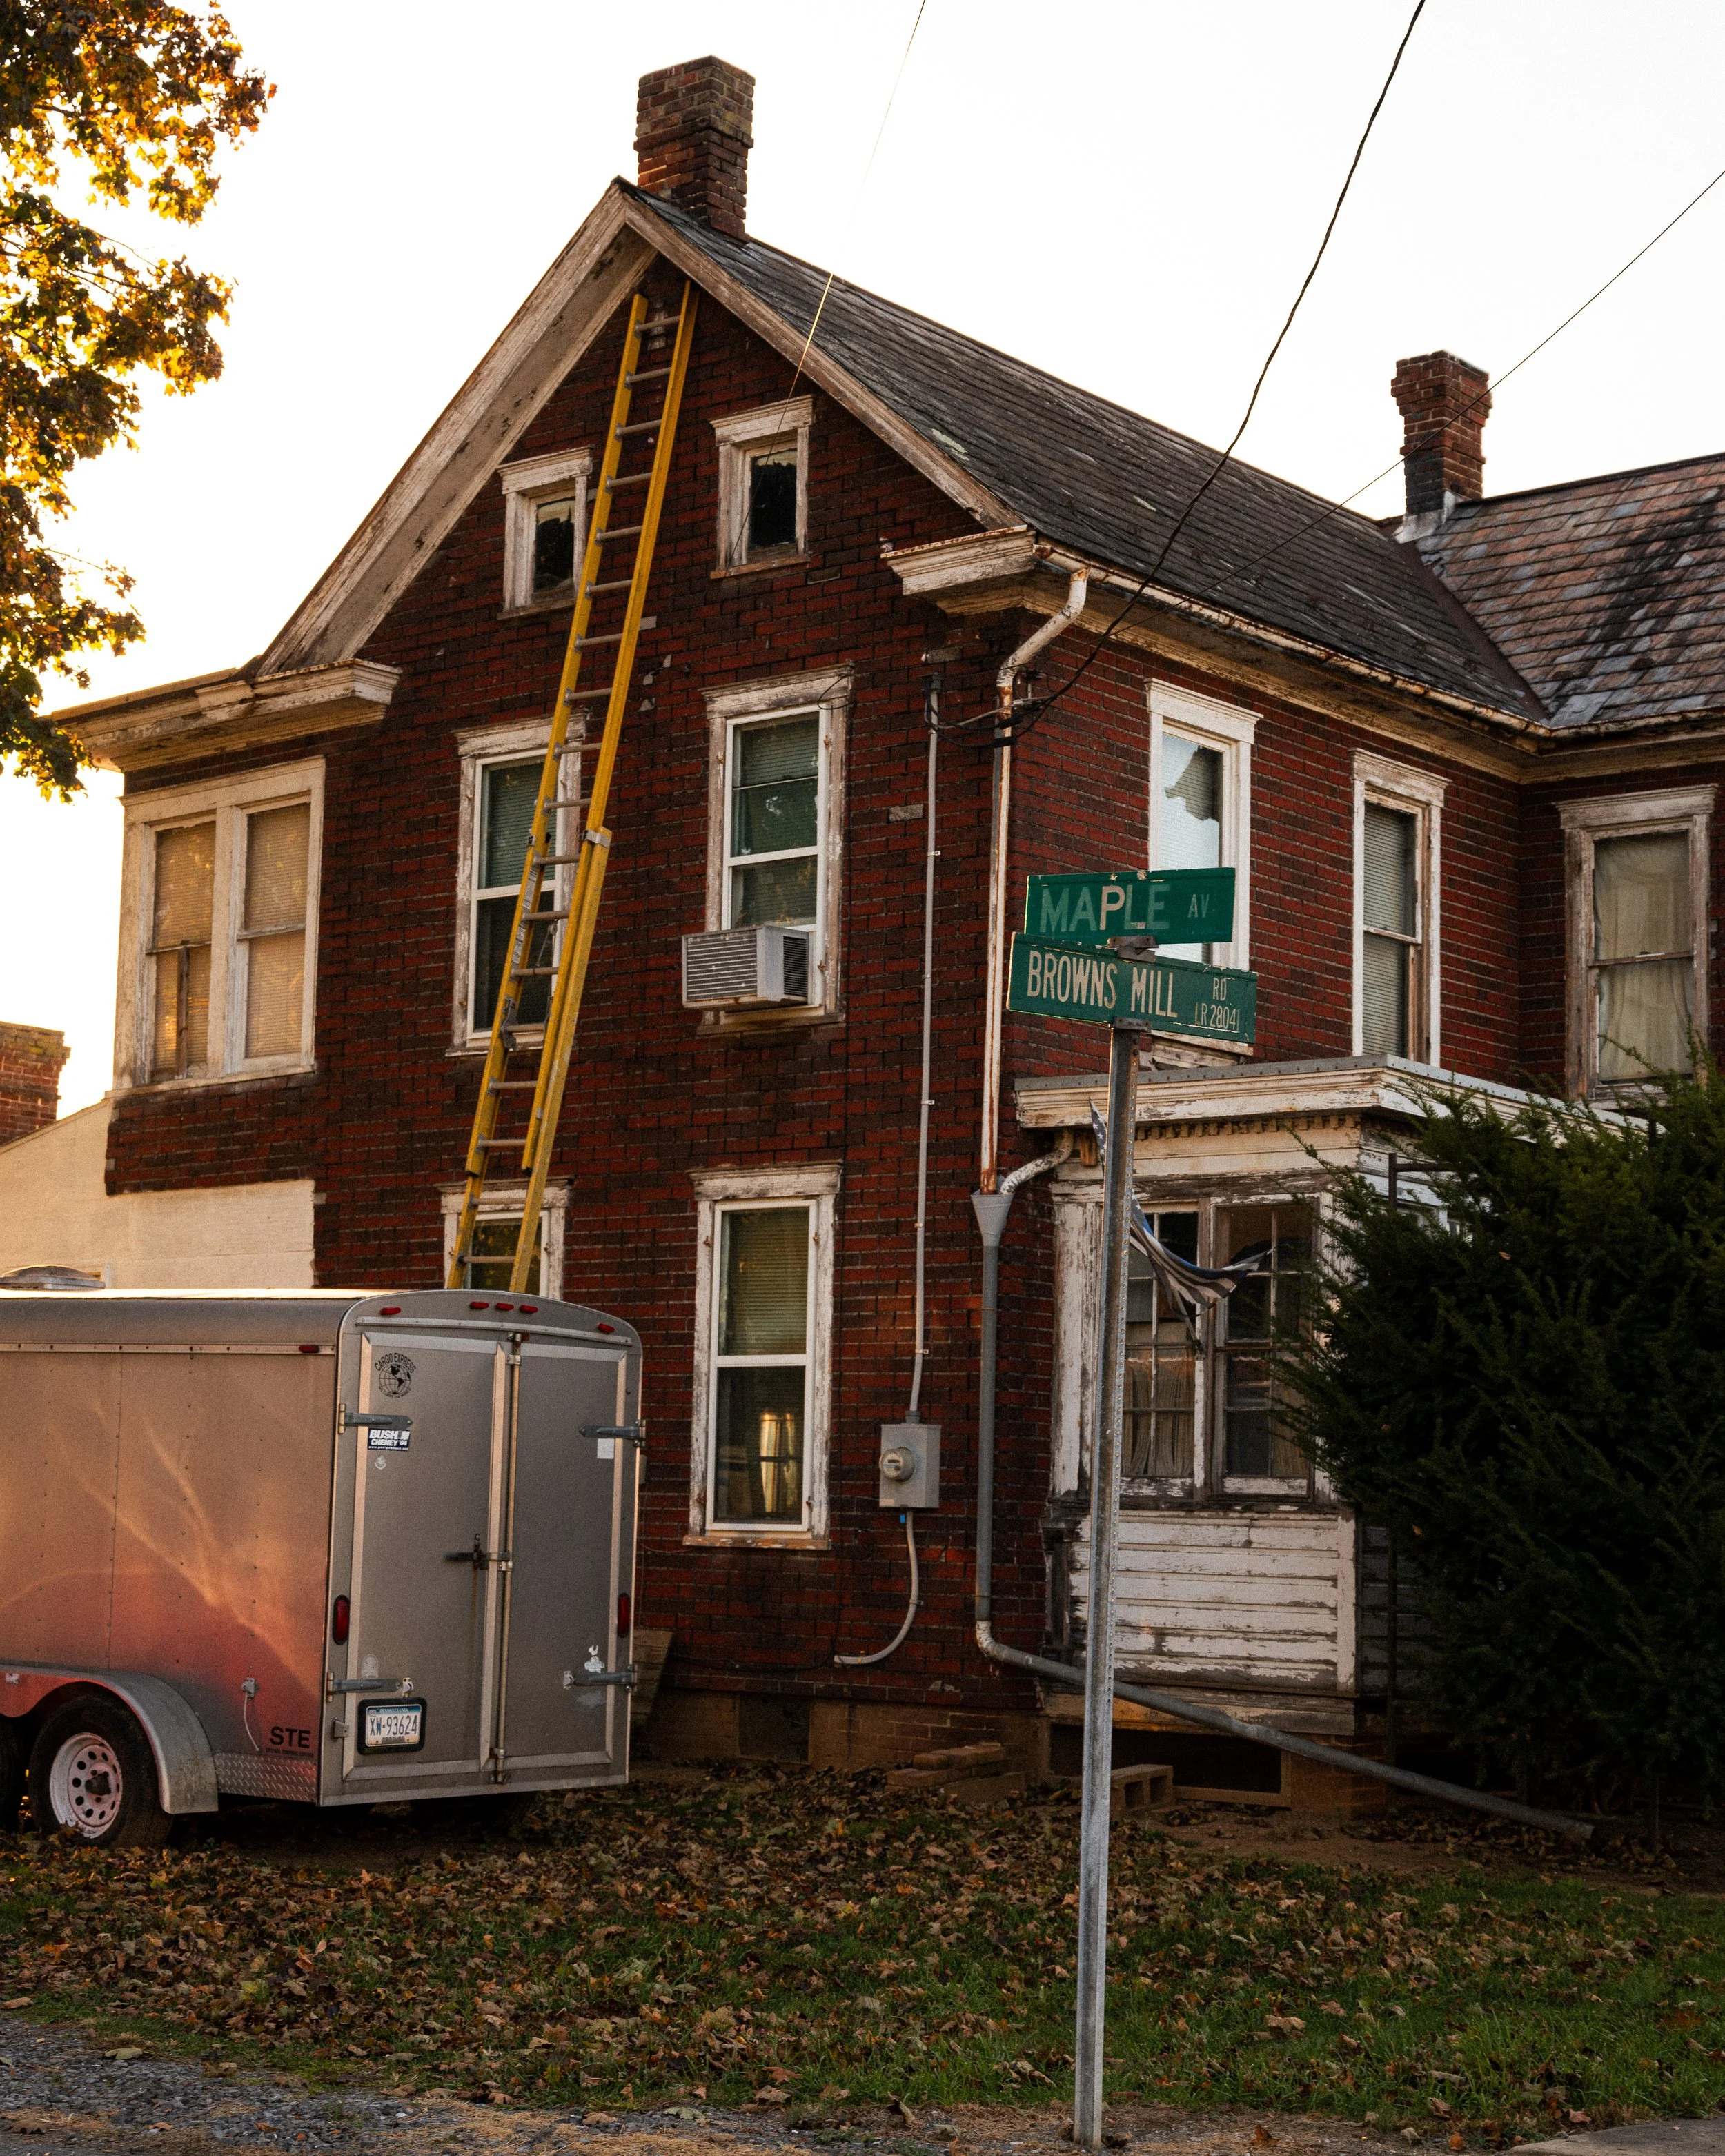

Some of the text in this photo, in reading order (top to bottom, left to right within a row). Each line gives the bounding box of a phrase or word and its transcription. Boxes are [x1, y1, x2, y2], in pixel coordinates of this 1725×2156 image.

[1039, 884, 1210, 933] MAPLE AV
[1027, 950, 1178, 1018] BROWNS MILL
[1212, 977, 1227, 1001] RD
[1195, 1003, 1208, 1026] LR
[375, 1352, 416, 1373] CARGO EXPRESS
[369, 1430, 398, 1439] BUSH
[270, 1725, 310, 1748] STE
